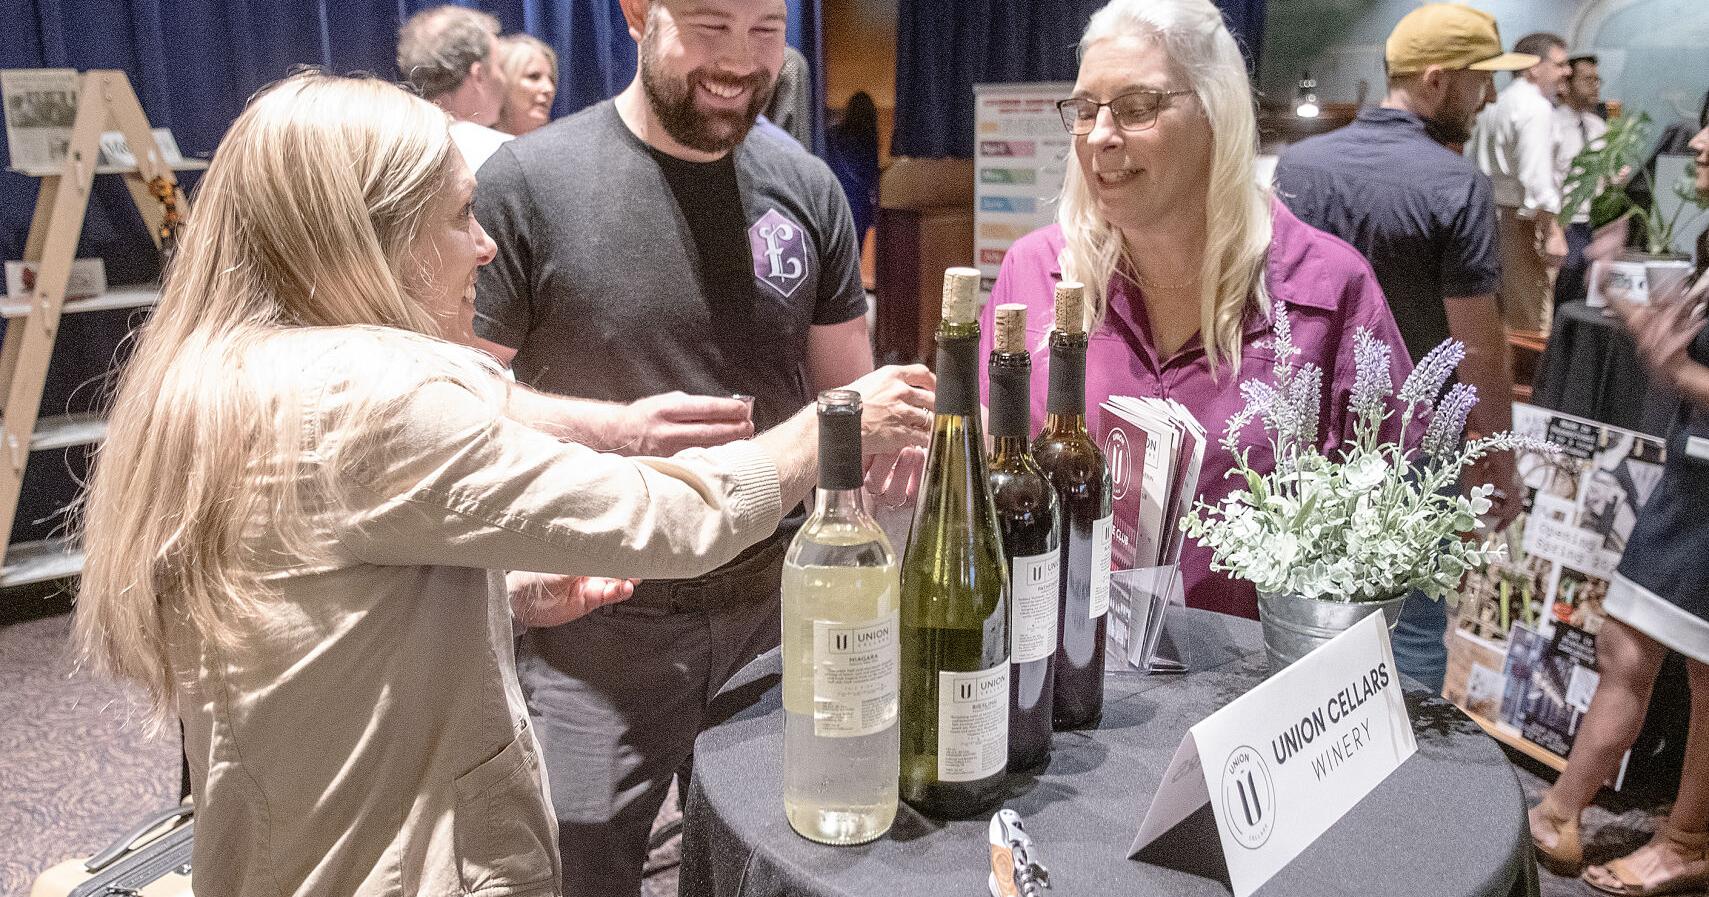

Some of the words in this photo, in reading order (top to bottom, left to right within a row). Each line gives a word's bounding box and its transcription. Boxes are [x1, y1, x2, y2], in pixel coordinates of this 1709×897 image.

[1116, 528, 1129, 546] CLUB
[857, 627, 889, 642] UNION
[980, 675, 1005, 690] UNION
[1272, 706, 1326, 765] UNION
[1327, 662, 1389, 723] CELLARS
[1311, 717, 1371, 782] WINERY
[1229, 753, 1250, 775] UNION
